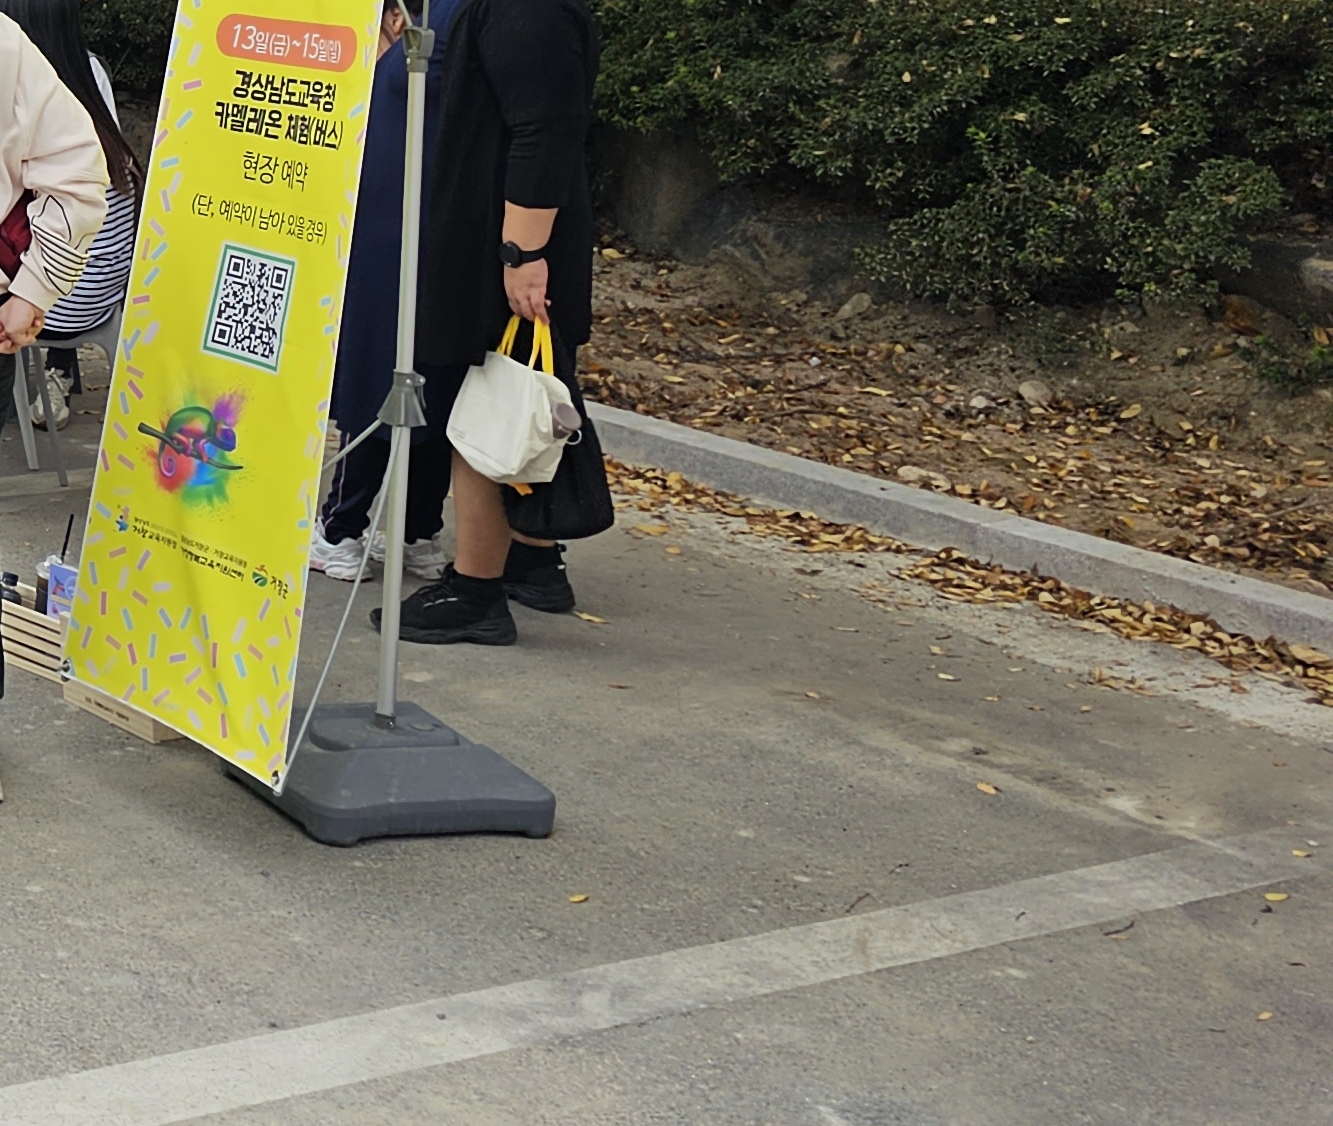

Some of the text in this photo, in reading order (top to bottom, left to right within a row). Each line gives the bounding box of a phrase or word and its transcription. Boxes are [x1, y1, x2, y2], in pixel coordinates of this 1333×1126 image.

[233, 70, 336, 113] 경상남도교육청
[214, 101, 344, 151] 카멜레온 체험(버스)
[243, 151, 308, 192] 현장 예약
[219, 200, 257, 228] 예약이
[259, 208, 285, 234] 남아
[286, 214, 305, 240] 있을
